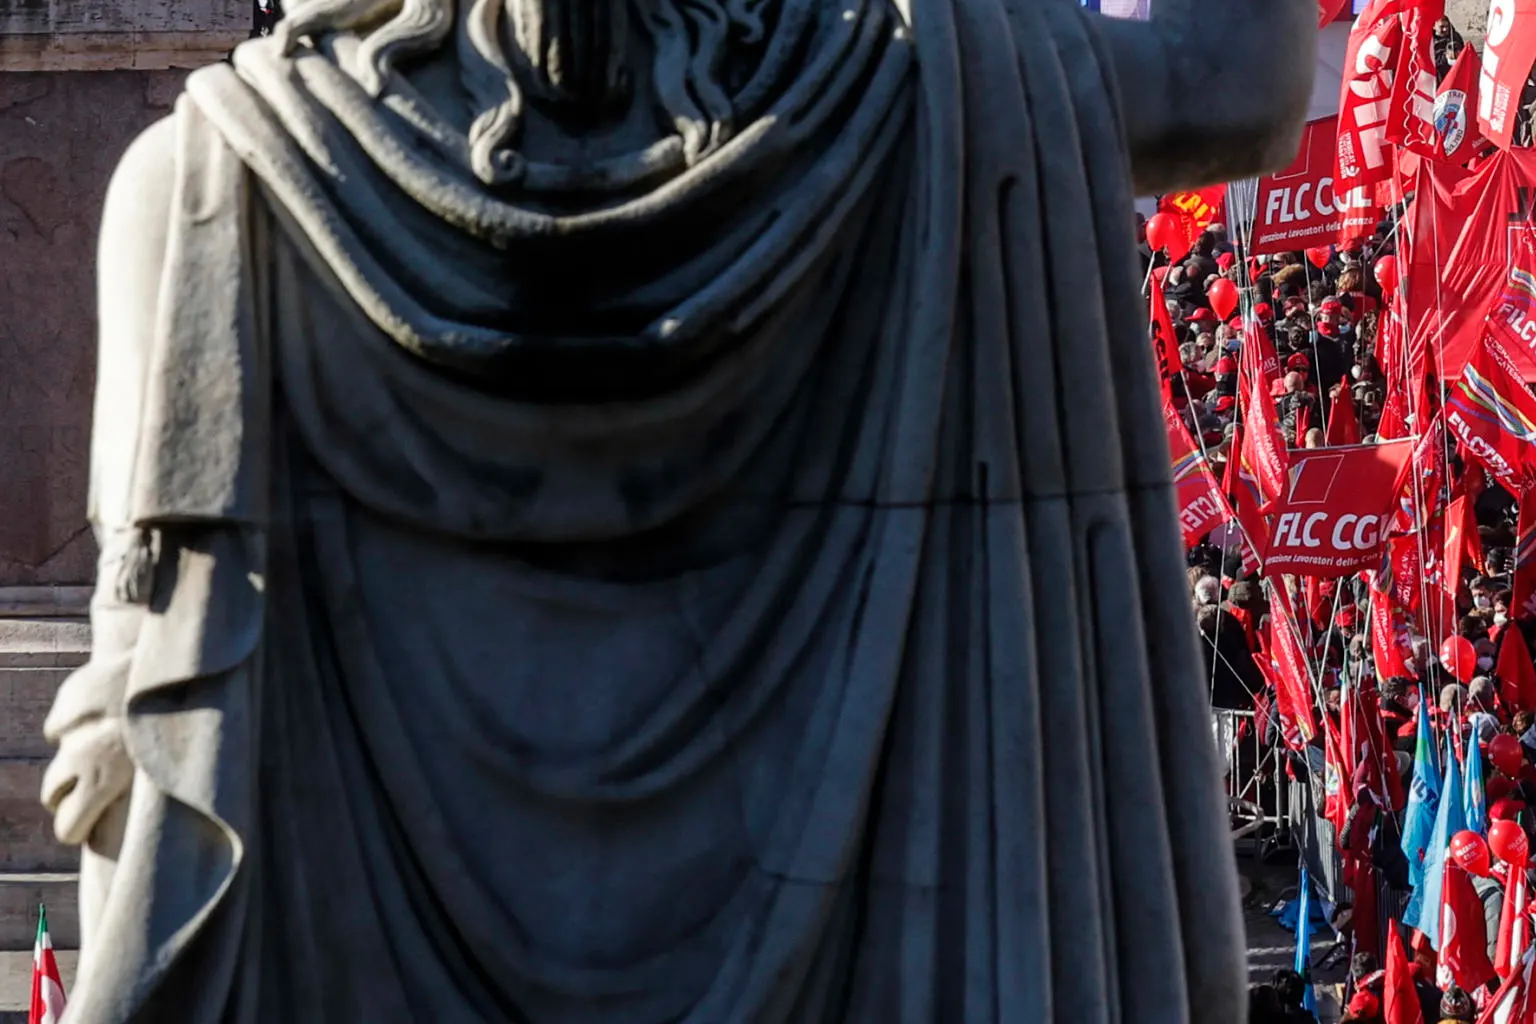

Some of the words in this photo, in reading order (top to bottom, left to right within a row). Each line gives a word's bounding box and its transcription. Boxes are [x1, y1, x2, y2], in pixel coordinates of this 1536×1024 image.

[1265, 182, 1311, 225] FLC
[1272, 512, 1329, 549] FLC
[1293, 554, 1334, 567] Lavoratori
